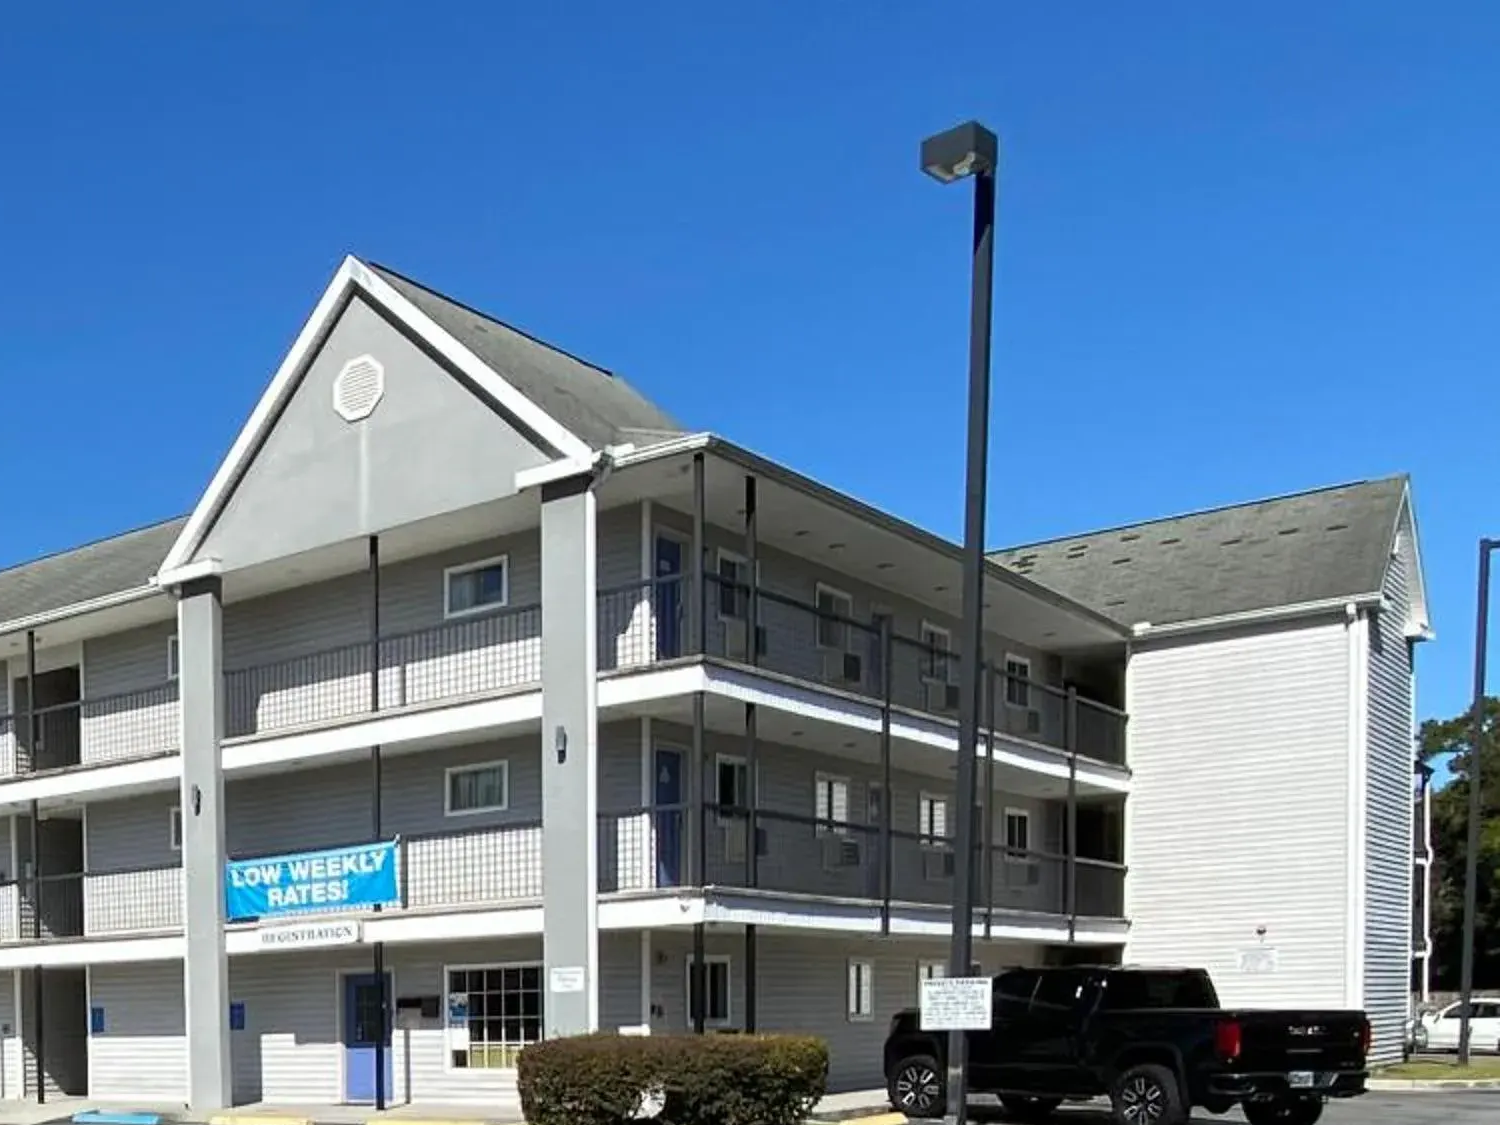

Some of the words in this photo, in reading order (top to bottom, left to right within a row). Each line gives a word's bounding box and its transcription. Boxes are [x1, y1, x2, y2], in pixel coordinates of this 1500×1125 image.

[230, 861, 283, 888] LOW
[289, 849, 387, 881] WEEKLY
[267, 879, 349, 907] RATES!
